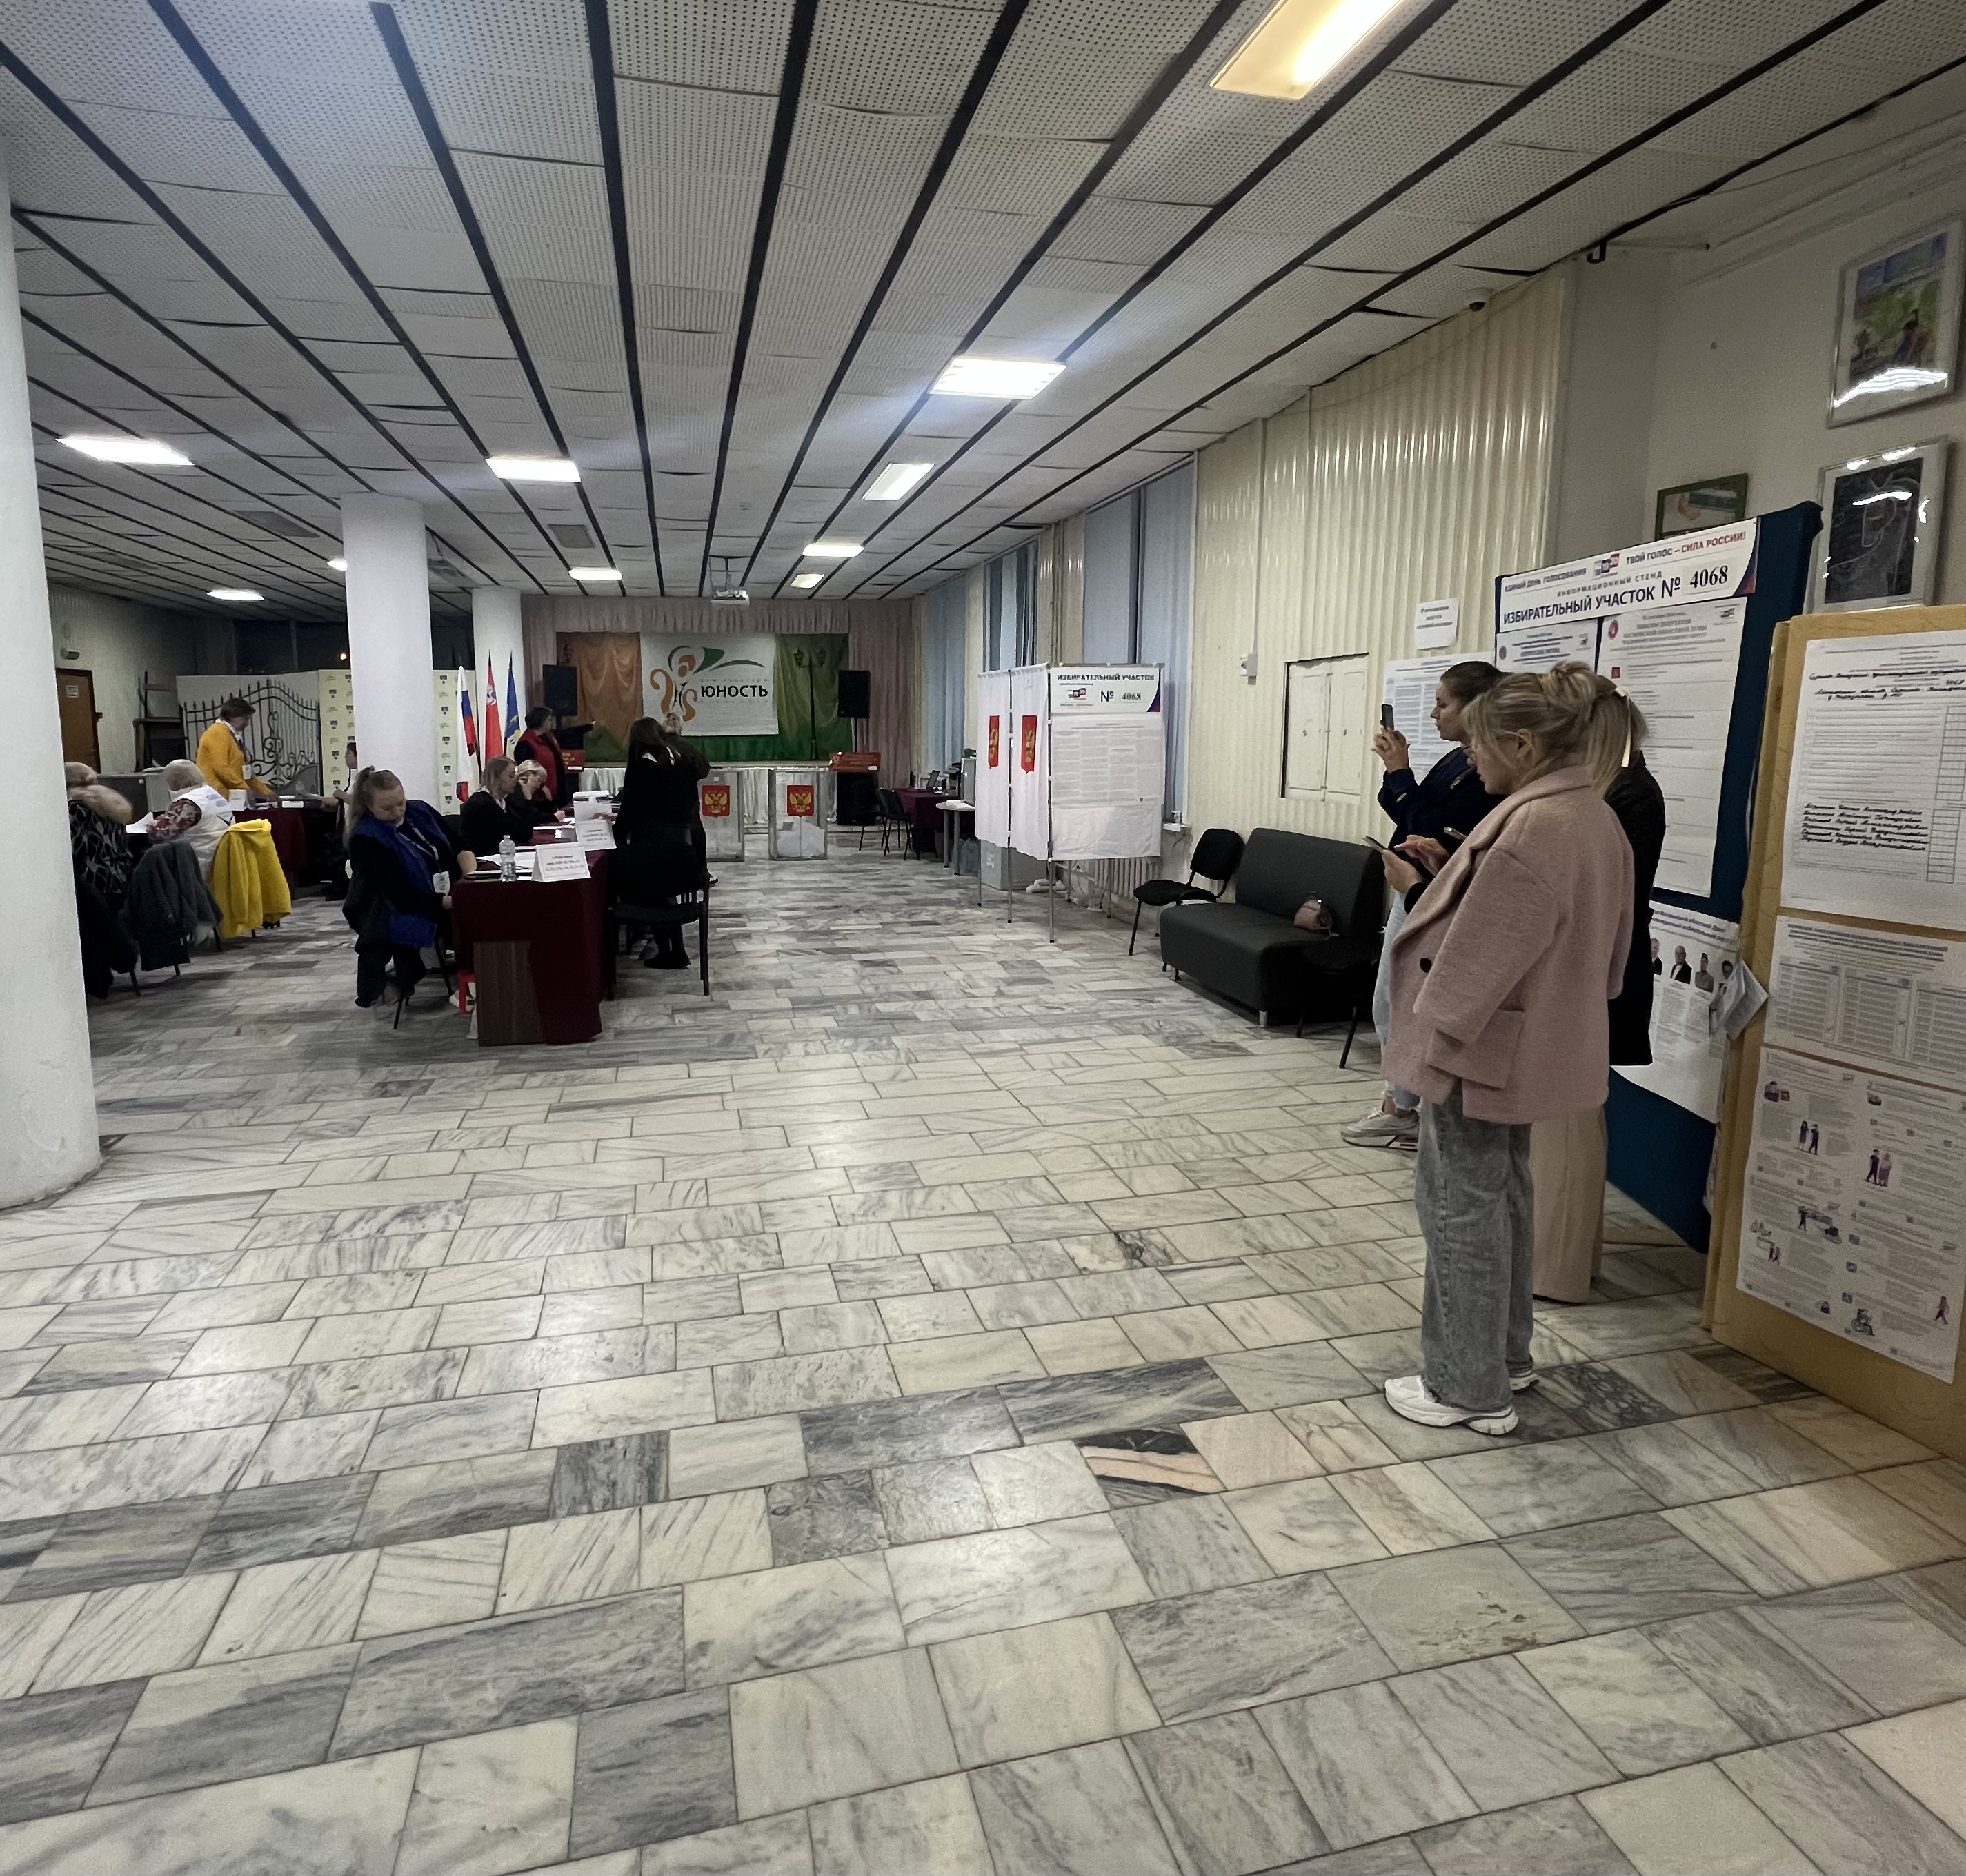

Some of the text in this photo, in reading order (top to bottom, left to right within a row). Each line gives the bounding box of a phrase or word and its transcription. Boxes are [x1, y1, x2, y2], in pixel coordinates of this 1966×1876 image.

[1627, 552, 1645, 565] ТВОЙ
[1647, 547, 1673, 561] ГОЛОС
[1681, 540, 1704, 553] СИЛА
[1706, 531, 1747, 548] РОССИИ!
[1503, 565, 1729, 624] ИЗБИРАТЕЛЬНЫЙ УЧАСТОК № 4068
[1557, 571, 1662, 597] ИНФОРМАЦИОННЫЙ СТЕНД
[700, 684, 768, 698] ЮНОСТЬ
[1100, 691, 1142, 702] № 4068
